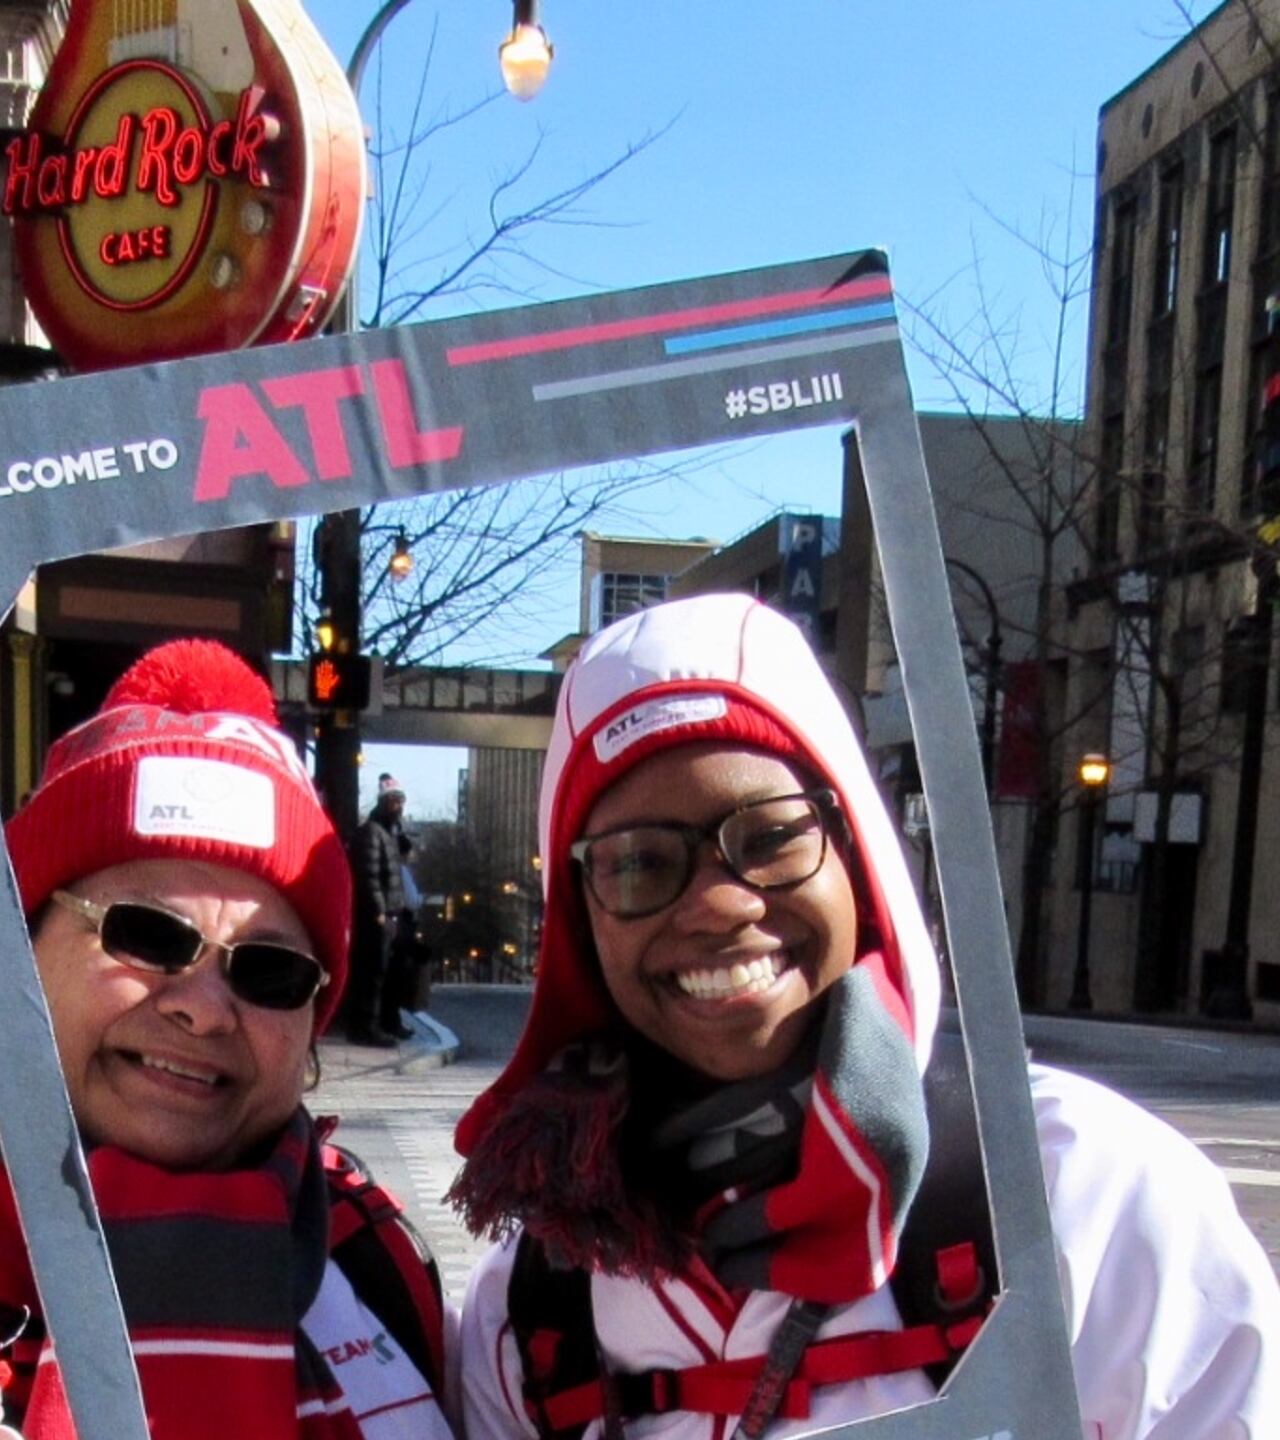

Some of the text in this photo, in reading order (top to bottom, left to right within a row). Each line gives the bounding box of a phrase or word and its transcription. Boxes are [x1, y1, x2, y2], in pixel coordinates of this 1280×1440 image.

[3, 86, 268, 215] Hard Rock
[99, 225, 173, 265] CAFE
[724, 372, 845, 420] #SBLIII
[123, 438, 179, 474] TO
[193, 358, 464, 502] ATL
[148, 803, 194, 821] ATL
